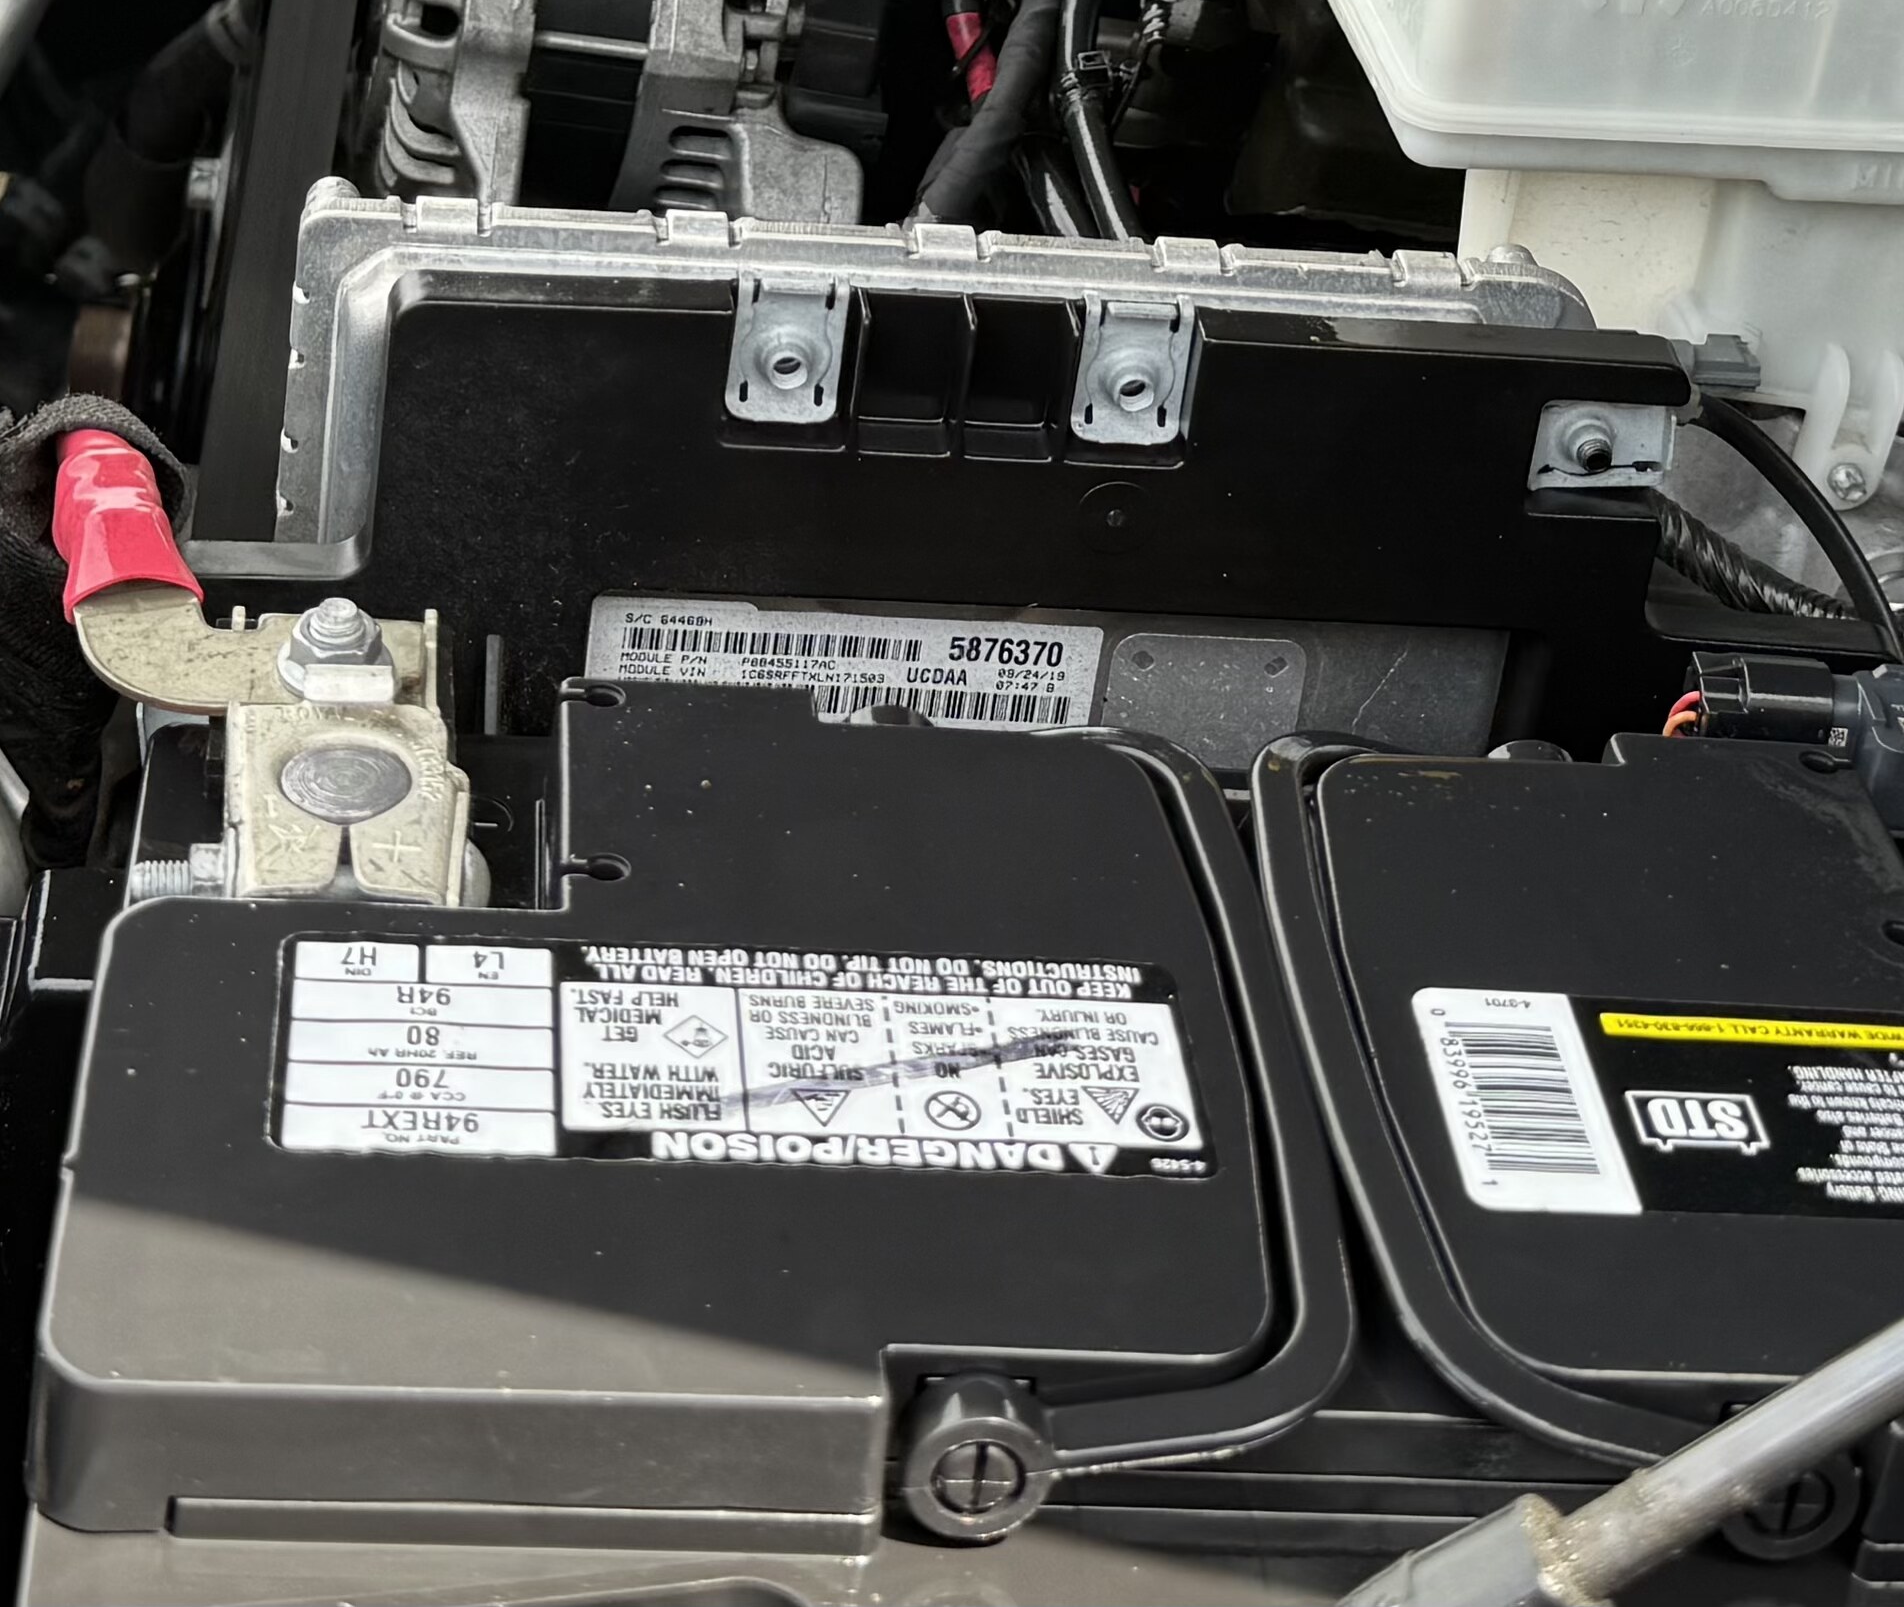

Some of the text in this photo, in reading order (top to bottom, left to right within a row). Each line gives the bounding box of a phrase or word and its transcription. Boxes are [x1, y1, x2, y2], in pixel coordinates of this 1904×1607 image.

[620, 652, 672, 664] MODULE
[681, 654, 708, 665] P/N
[948, 636, 1064, 667] 5876370
[619, 664, 671, 676] MODULE
[680, 666, 706, 676] VIN
[906, 667, 968, 686] UCDAA
[340, 946, 378, 966] H7
[473, 950, 505, 970] L4
[580, 945, 1142, 983] INSTRUCTIONS. DO NOT TIP. DO NOT OPEN BATTERY.
[593, 964, 1132, 999] KEEP OUT OF THE REACH OF CHILDREN. READ ALL
[395, 985, 452, 1005] 94R
[568, 987, 680, 1009] HELP FAST.
[811, 995, 876, 1013] SEVERE
[573, 1005, 662, 1025] MEDICAL
[748, 1008, 872, 1028] BLINDNESS OR
[1035, 1007, 1127, 1026] OR INJURY.
[406, 1025, 440, 1046] 80
[602, 1025, 639, 1043] GET
[764, 1025, 859, 1044] CAN CAUSE
[1103, 1026, 1158, 1046] CAUSE
[1730, 1022, 1770, 1036] CALL
[1774, 1024, 1861, 1040] WARRANTY
[791, 1043, 837, 1062] ACID
[1075, 1043, 1136, 1063] GASES
[395, 1068, 449, 1089] 790
[583, 1060, 721, 1084] WITH WATER.
[767, 1061, 864, 1081] SULFURIC
[1034, 1061, 1139, 1082] EXPLOSIVE
[581, 1081, 722, 1102] IMMEDIATELY
[1022, 1087, 1080, 1106] EYES.
[360, 1109, 480, 1133] 94REXT
[656, 1102, 722, 1122] FLUSH
[1016, 1105, 1084, 1126] SHIELD
[1646, 1098, 1746, 1140] STD
[383, 1133, 460, 1145] PART NO.
[650, 1131, 1064, 1167] DANGER/POISON
